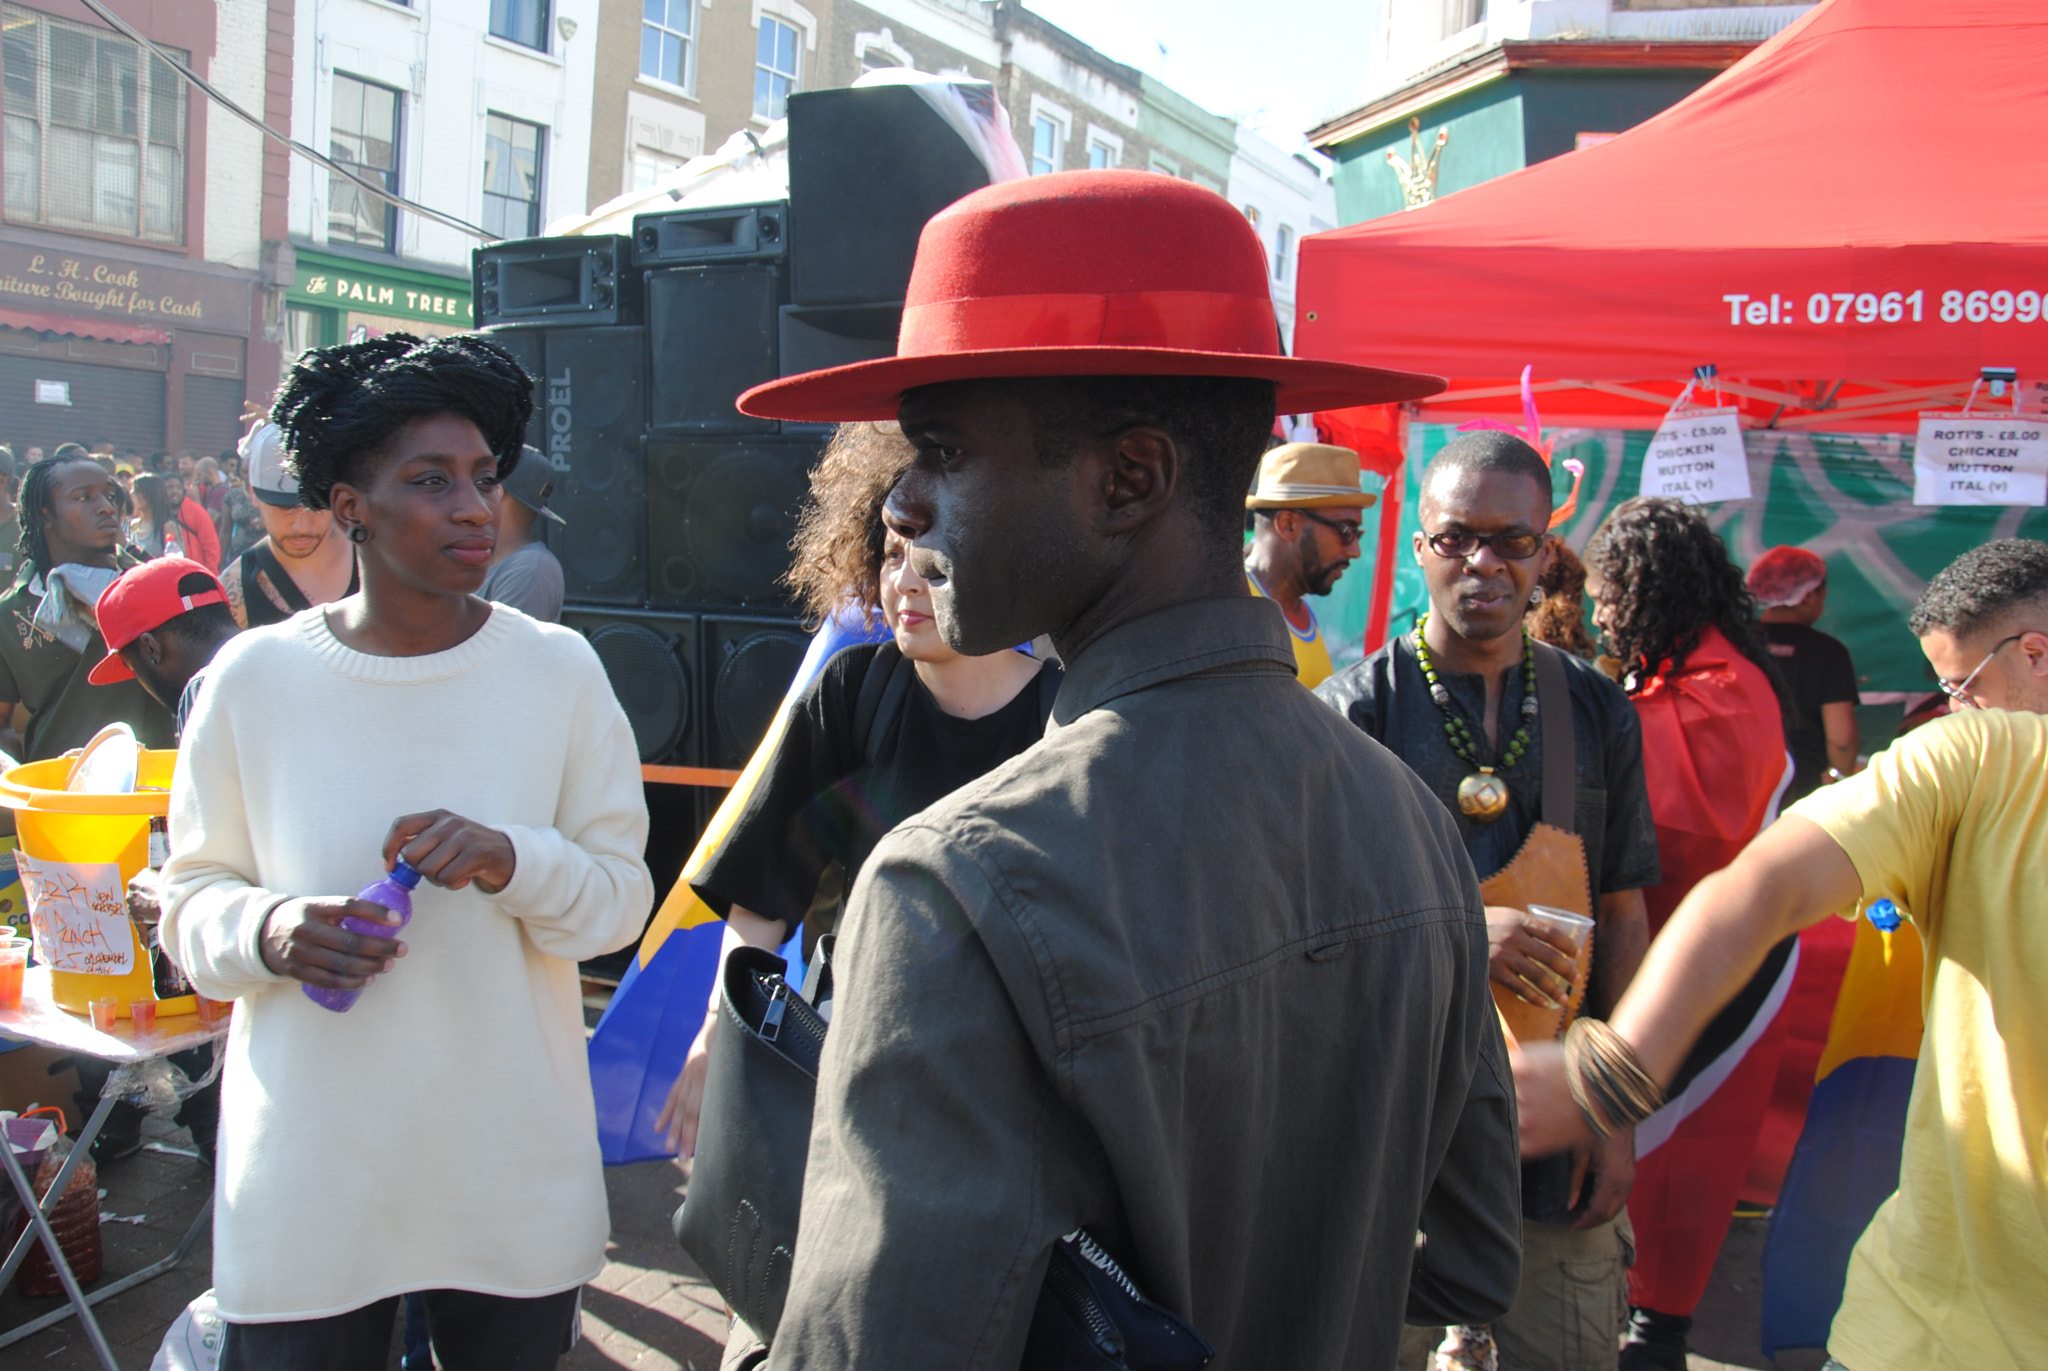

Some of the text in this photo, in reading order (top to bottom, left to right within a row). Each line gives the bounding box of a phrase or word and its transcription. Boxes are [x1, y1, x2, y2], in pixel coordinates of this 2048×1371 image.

[93, 265, 139, 288] Cook
[55, 281, 125, 310] Bought
[128, 291, 157, 314] for
[160, 296, 203, 318] Cash
[306, 276, 328, 294] The
[337, 279, 394, 305] PALM
[406, 291, 457, 315] TREE
[1723, 294, 1793, 325] Tel:
[1807, 290, 1924, 324] 07961
[550, 367, 571, 472] PROEL
[1934, 430, 1984, 441] ROTI'S
[1998, 430, 2041, 441] £8.00
[1948, 447, 2019, 458] CHICKEN
[1947, 463, 2014, 473] MUTTON
[1950, 481, 1984, 491] ITAL
